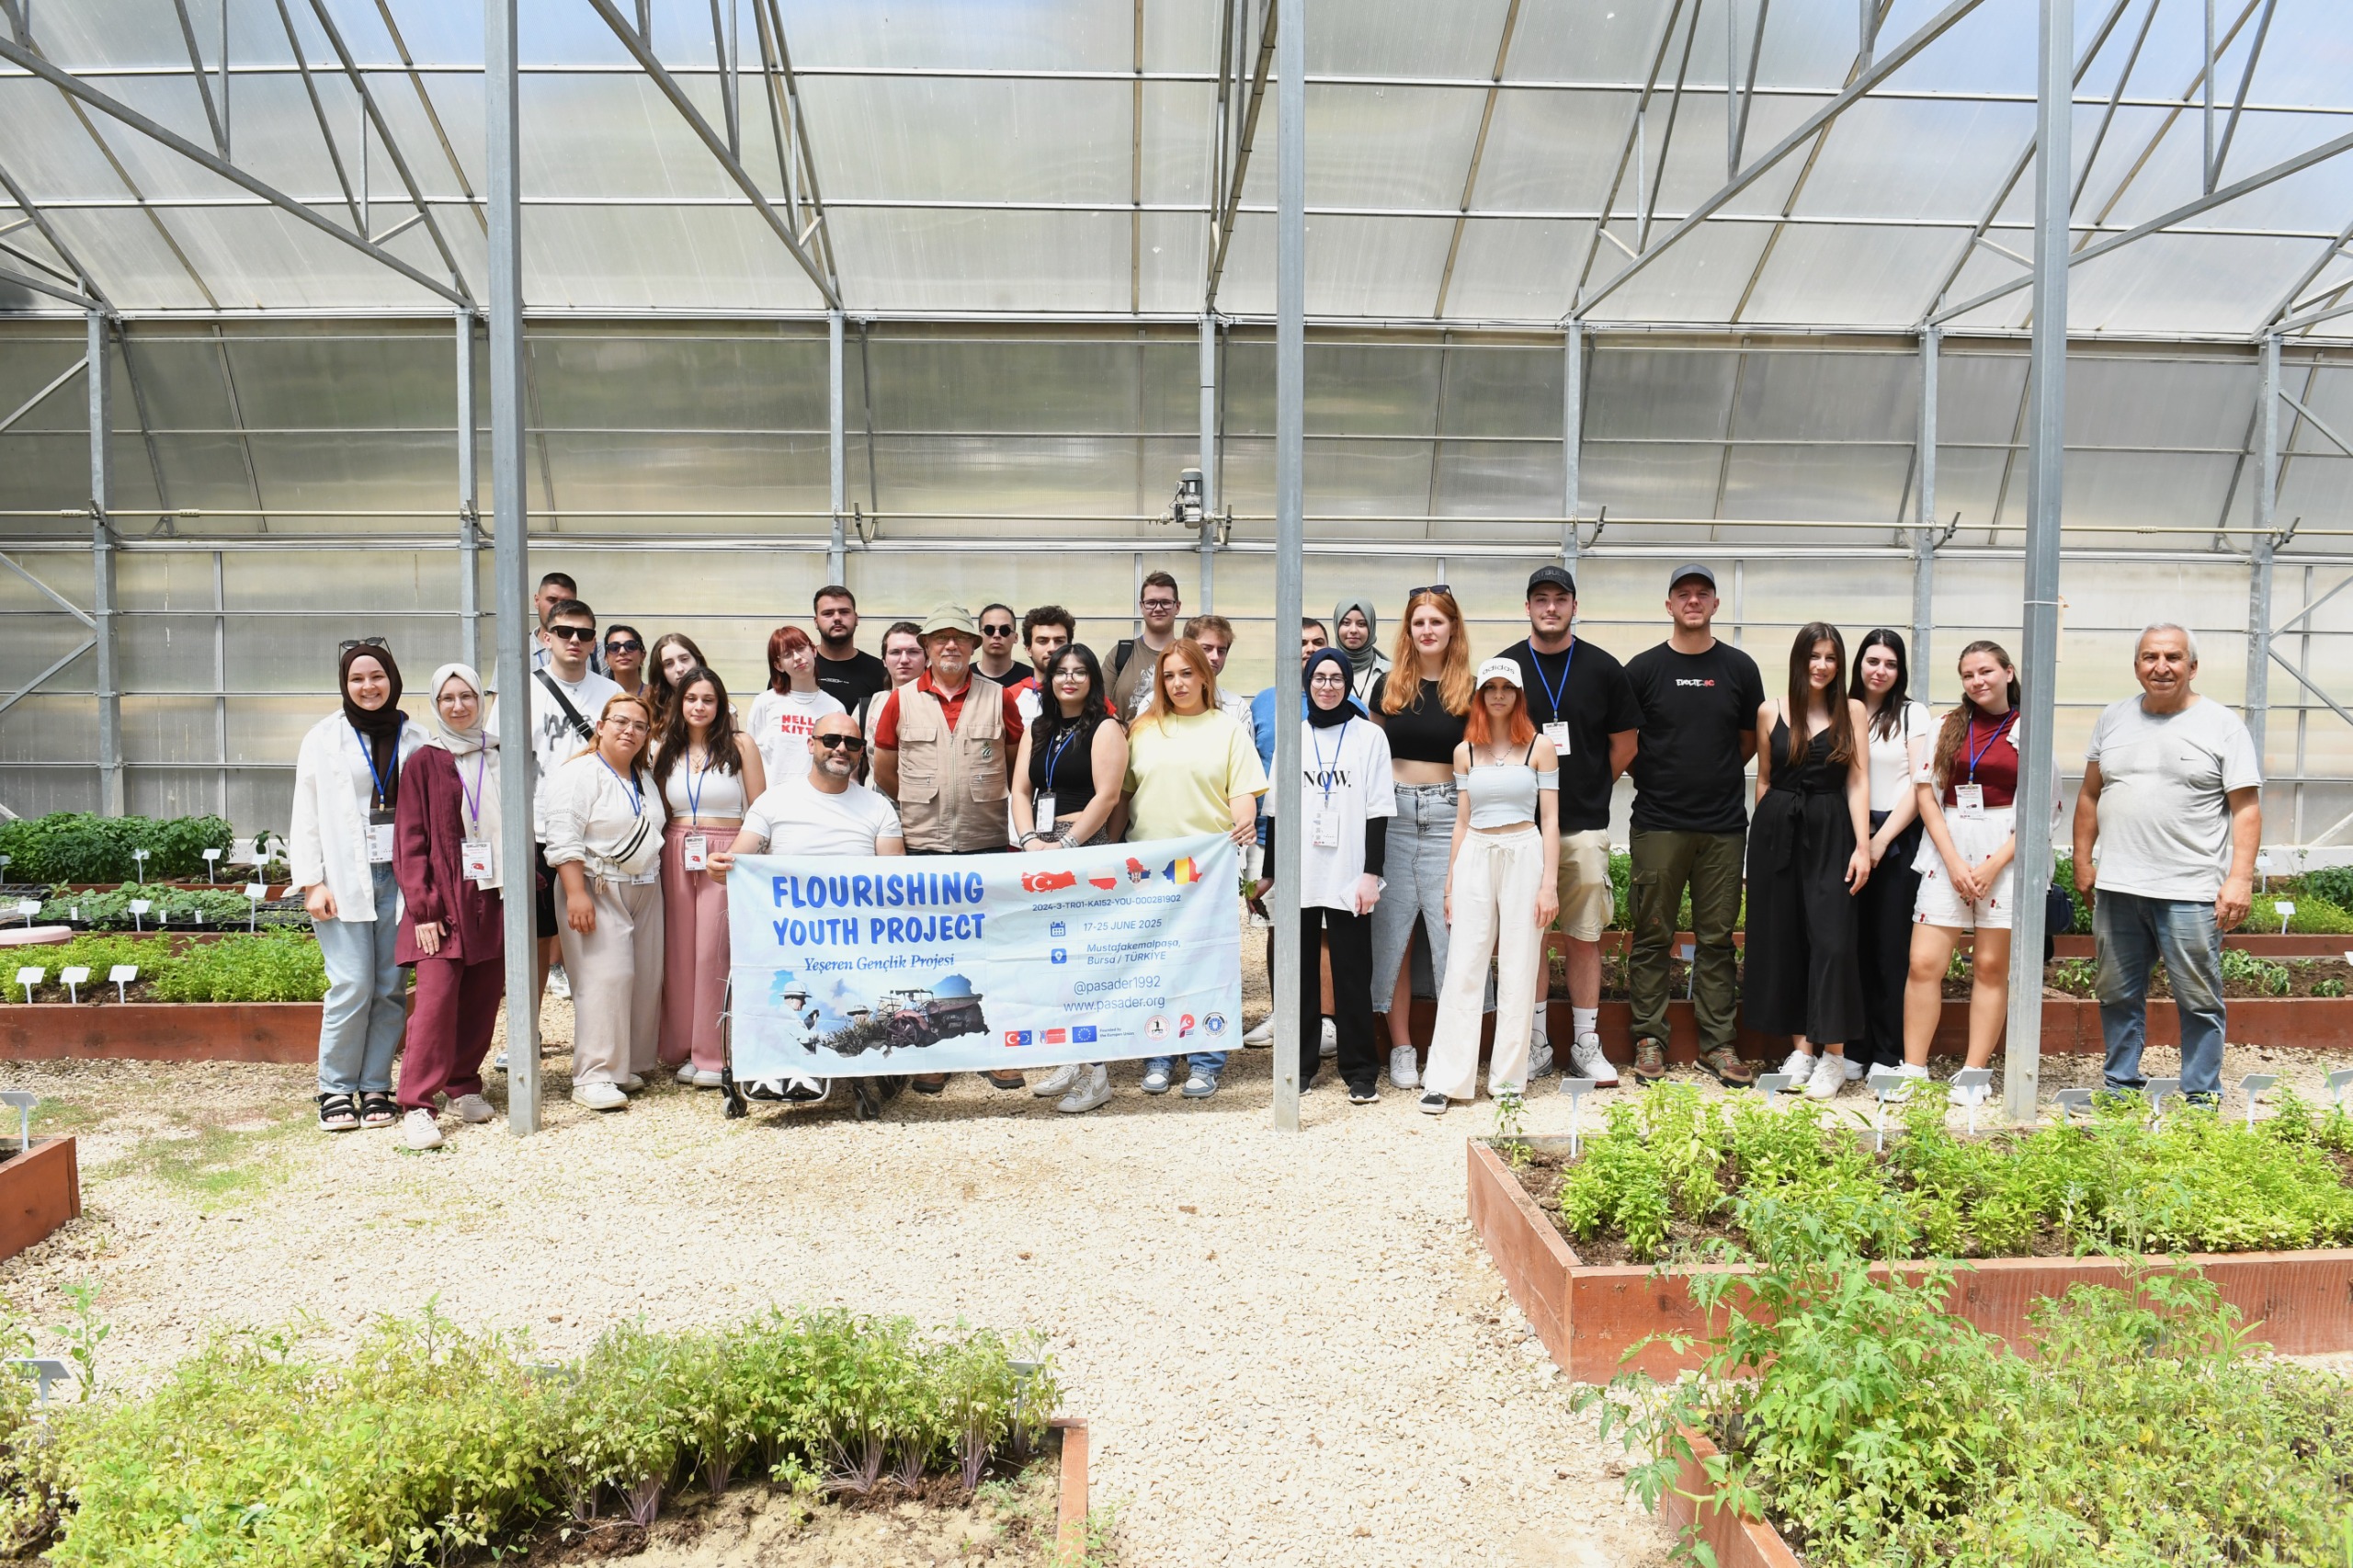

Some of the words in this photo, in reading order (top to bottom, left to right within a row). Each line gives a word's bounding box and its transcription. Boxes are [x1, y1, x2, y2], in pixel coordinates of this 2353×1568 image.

[1482, 665, 1515, 675] adidas
[781, 714, 815, 726] HELL
[781, 724, 813, 736] KITT
[1302, 770, 1351, 788] NOW.
[772, 871, 984, 909] FLOURISHING
[1032, 894, 1181, 912] 2024-3-TR01-KA152-YOU-000281902
[772, 917, 858, 946] YOUTH
[870, 913, 985, 945] PROJECT
[1084, 922, 1108, 931] 17-25
[1110, 920, 1136, 930] JUNE
[1139, 918, 1163, 929] 2025
[1086, 938, 1181, 954] Mustafakemalpaşa,
[804, 957, 853, 974] Yeşeren
[857, 955, 906, 972] Gençlik
[911, 953, 955, 970] Projesi
[1087, 955, 1116, 965] Bursa
[1124, 950, 1166, 963] TÜRKİYE
[1074, 975, 1161, 995] @pasader1992
[1063, 996, 1165, 1012] www.pasader.org
